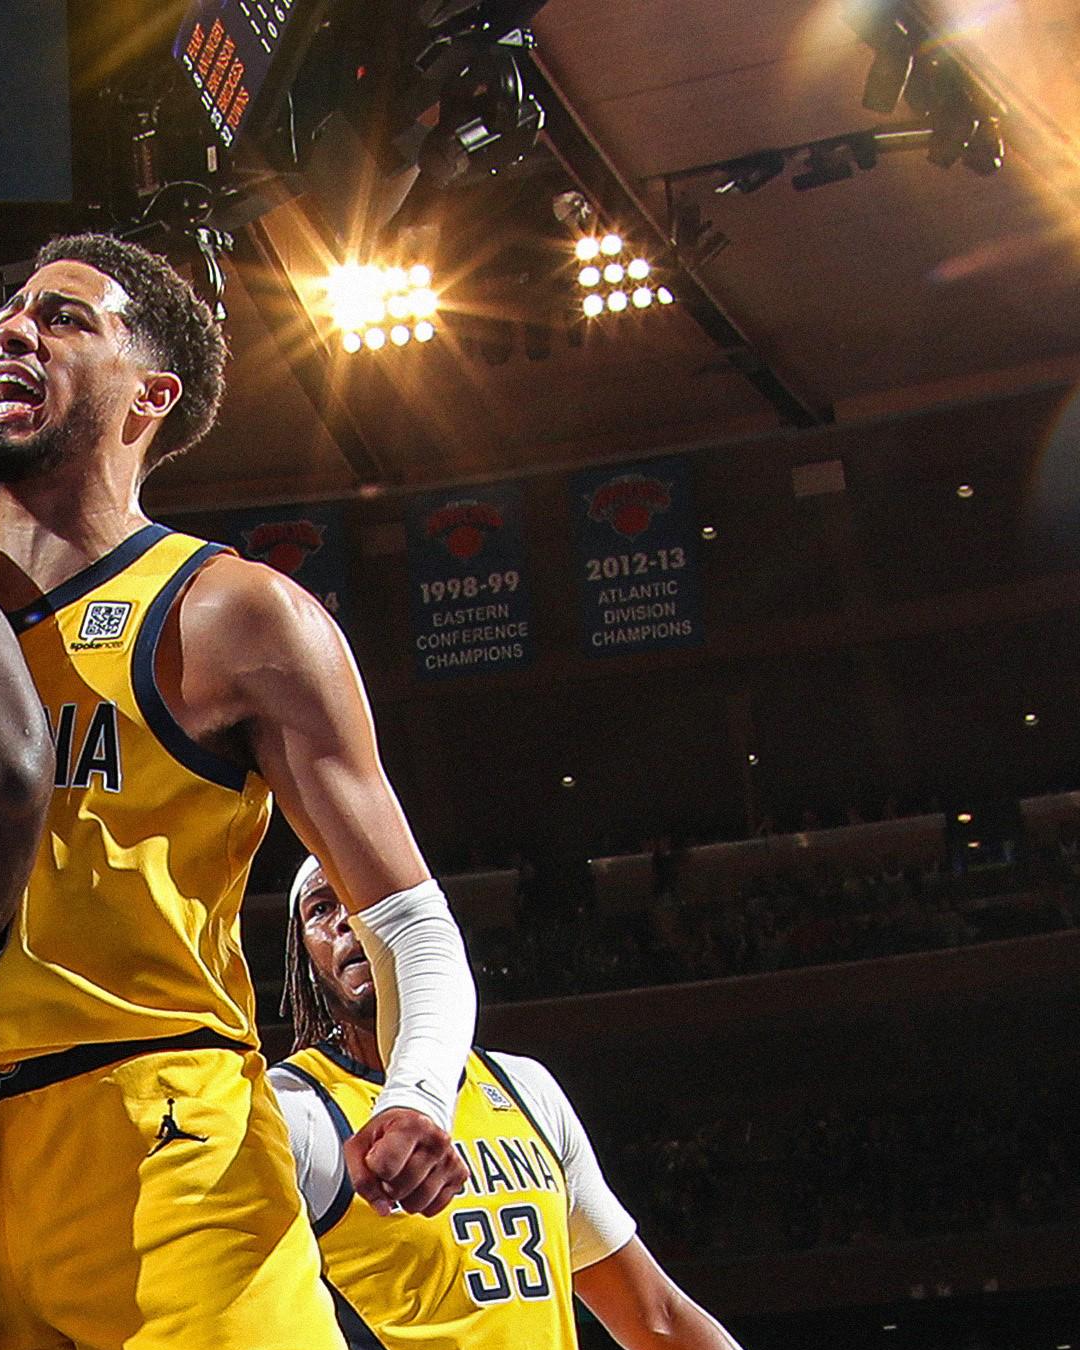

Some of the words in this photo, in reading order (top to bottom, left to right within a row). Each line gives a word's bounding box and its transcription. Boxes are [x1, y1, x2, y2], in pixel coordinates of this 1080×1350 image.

[585, 547, 687, 582] 2012-13
[420, 570, 520, 604] 1998-99
[598, 580, 679, 606] ATLANTIC
[432, 603, 509, 628] EASTERN
[603, 601, 676, 625] DIVISION
[415, 621, 529, 651] CONFERENCE
[591, 619, 693, 647] CHAMPIONS
[424, 642, 524, 671] CHAMPIONS
[454, 1138, 560, 1195] IANA
[450, 1202, 553, 1308] 33
